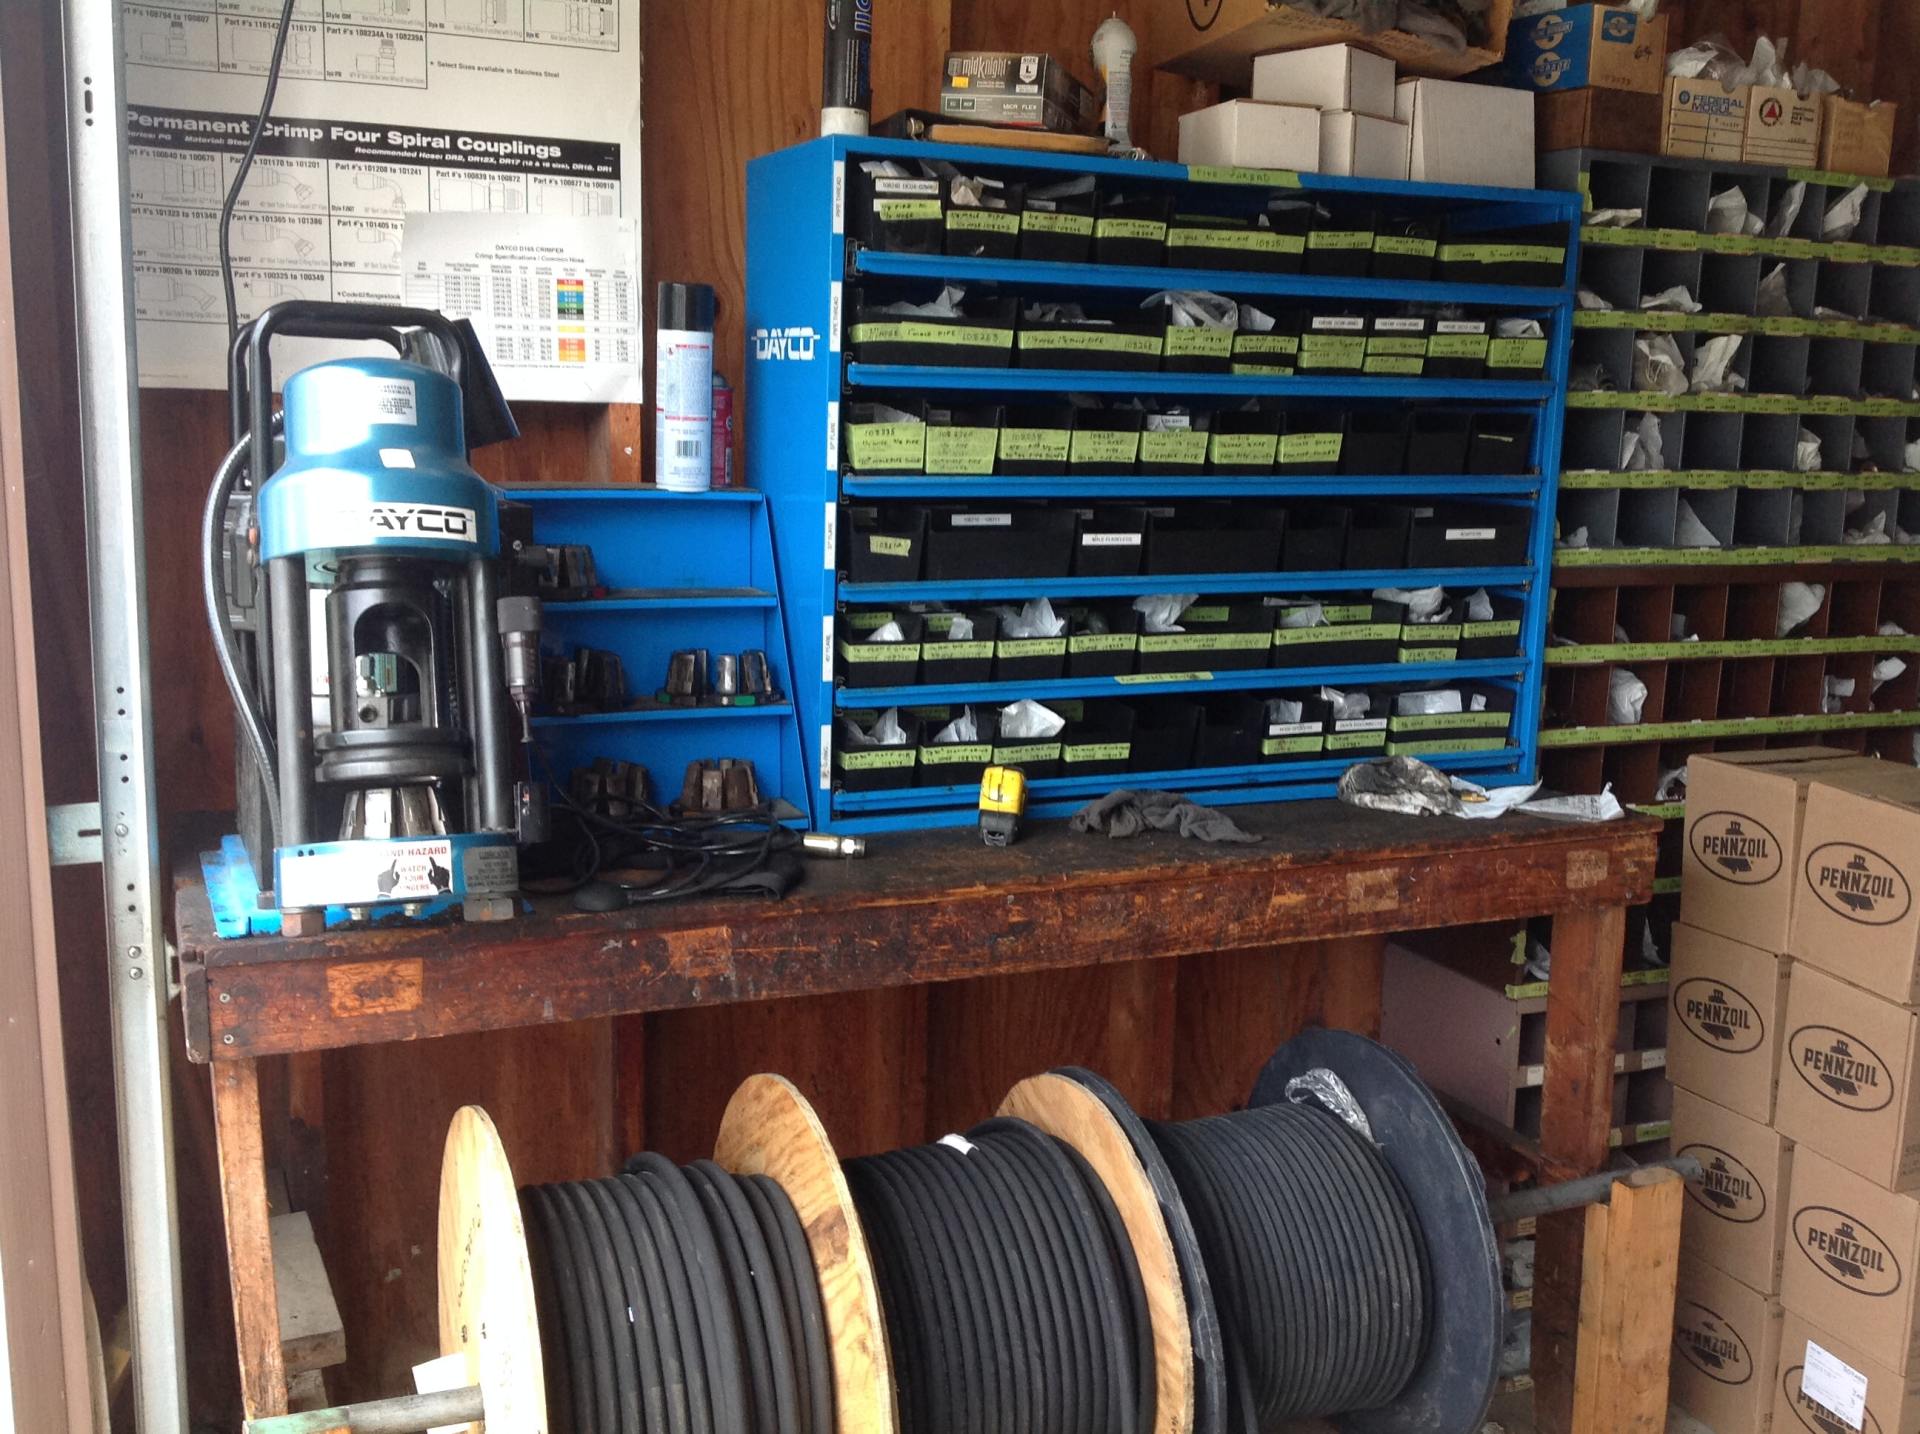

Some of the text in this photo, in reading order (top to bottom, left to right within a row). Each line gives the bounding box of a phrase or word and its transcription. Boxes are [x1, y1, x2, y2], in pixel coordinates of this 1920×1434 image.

[327, 26, 341, 34] Part
[477, 65, 505, 73] available
[514, 68, 542, 77] Stainless
[1025, 64, 1032, 75] L
[1692, 95, 1744, 109] FEDERAL
[128, 111, 251, 136] Permanent
[331, 127, 381, 143] Four
[387, 131, 451, 150] Spiral
[457, 137, 562, 160] Couplings
[355, 147, 417, 159] Recommended
[336, 163, 349, 171] Part
[436, 170, 450, 178] Part
[533, 177, 547, 185] Part
[232, 213, 246, 221] Part
[337, 219, 351, 227] Part
[475, 252, 494, 260] Crimp
[234, 271, 249, 279] Part
[755, 327, 817, 361] DAYCO
[368, 508, 468, 535] AYCO
[408, 846, 448, 857] HAZARD
[1703, 835, 1769, 859] PENNZOIL
[1819, 866, 1896, 899] PENNZOIL
[1687, 998, 1751, 1030] PENNZOIL
[1803, 1047, 1879, 1087] PENNZOIL
[1697, 1168, 1753, 1201] ENNZOIL
[1807, 1226, 1885, 1273] PENNZOIL
